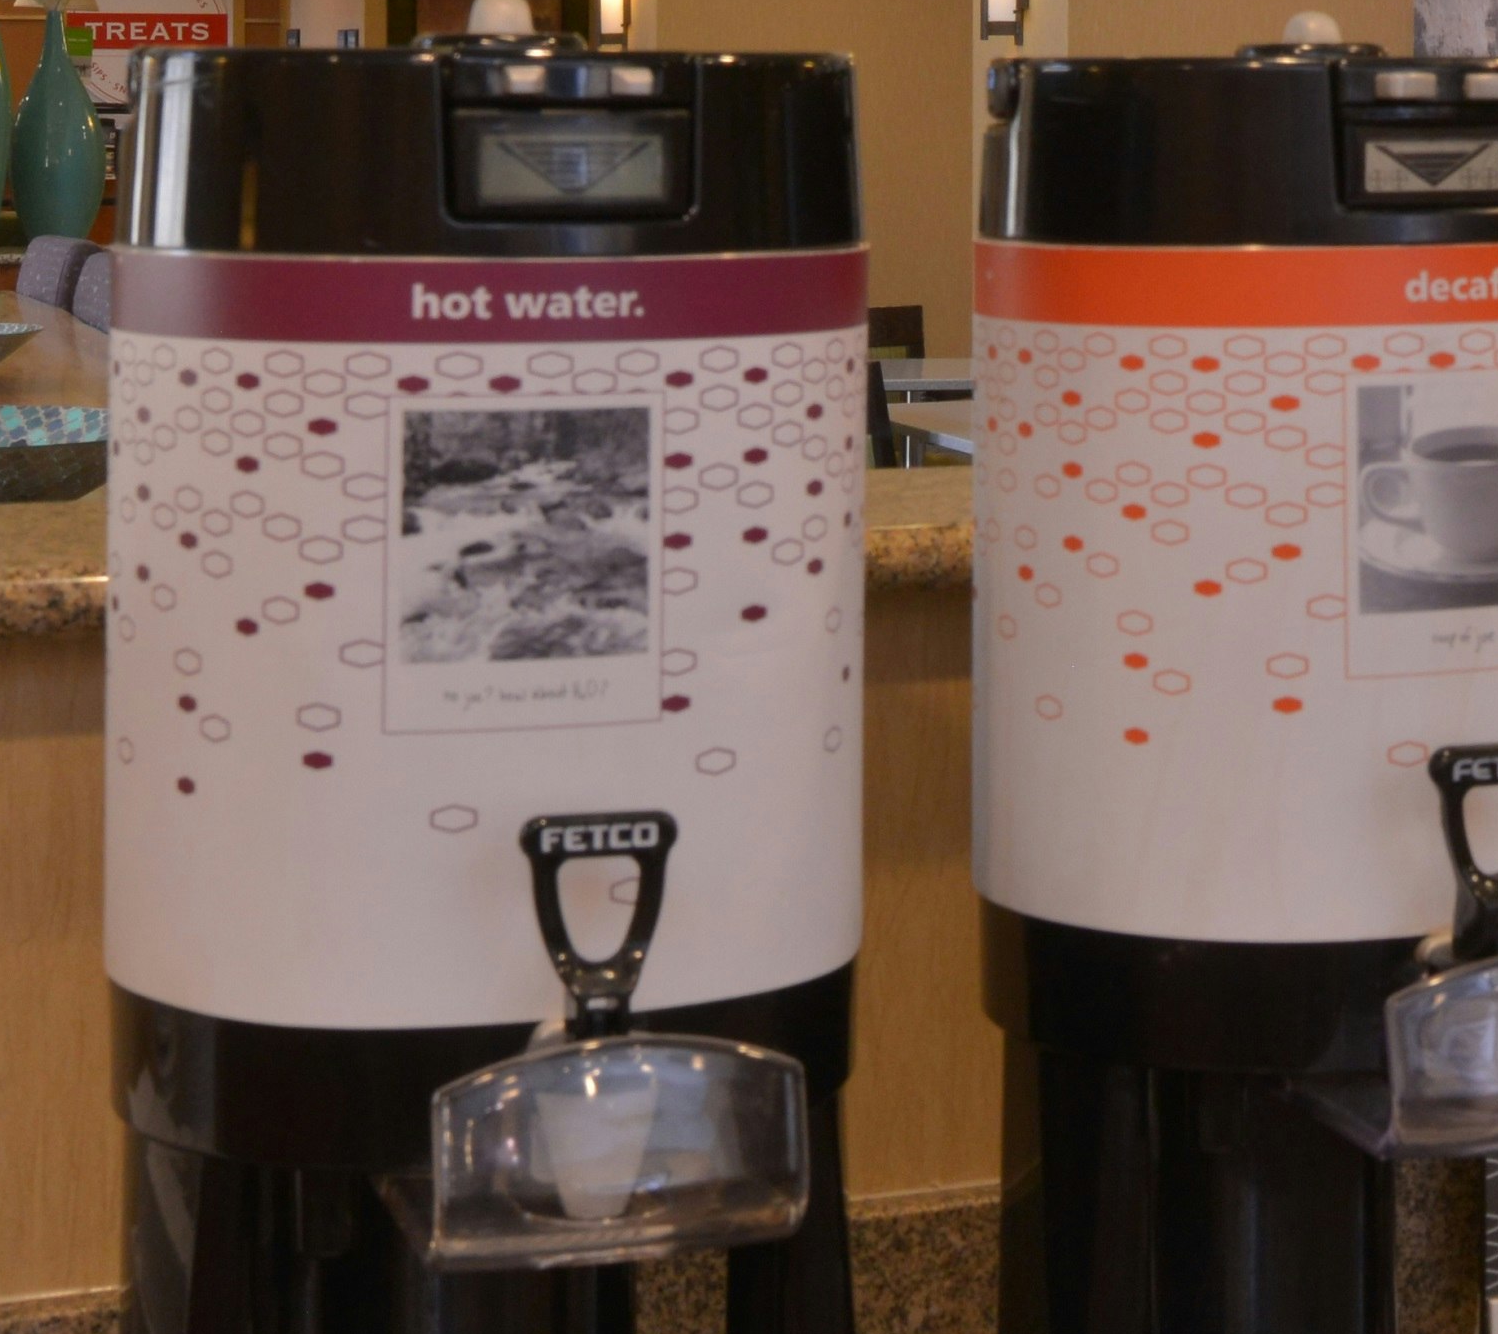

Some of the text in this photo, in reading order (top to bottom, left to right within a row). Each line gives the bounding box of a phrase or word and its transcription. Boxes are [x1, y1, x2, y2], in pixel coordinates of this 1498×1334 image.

[84, 21, 210, 42] TREATS
[410, 282, 645, 320] hot water.
[540, 821, 660, 854] FETCO
